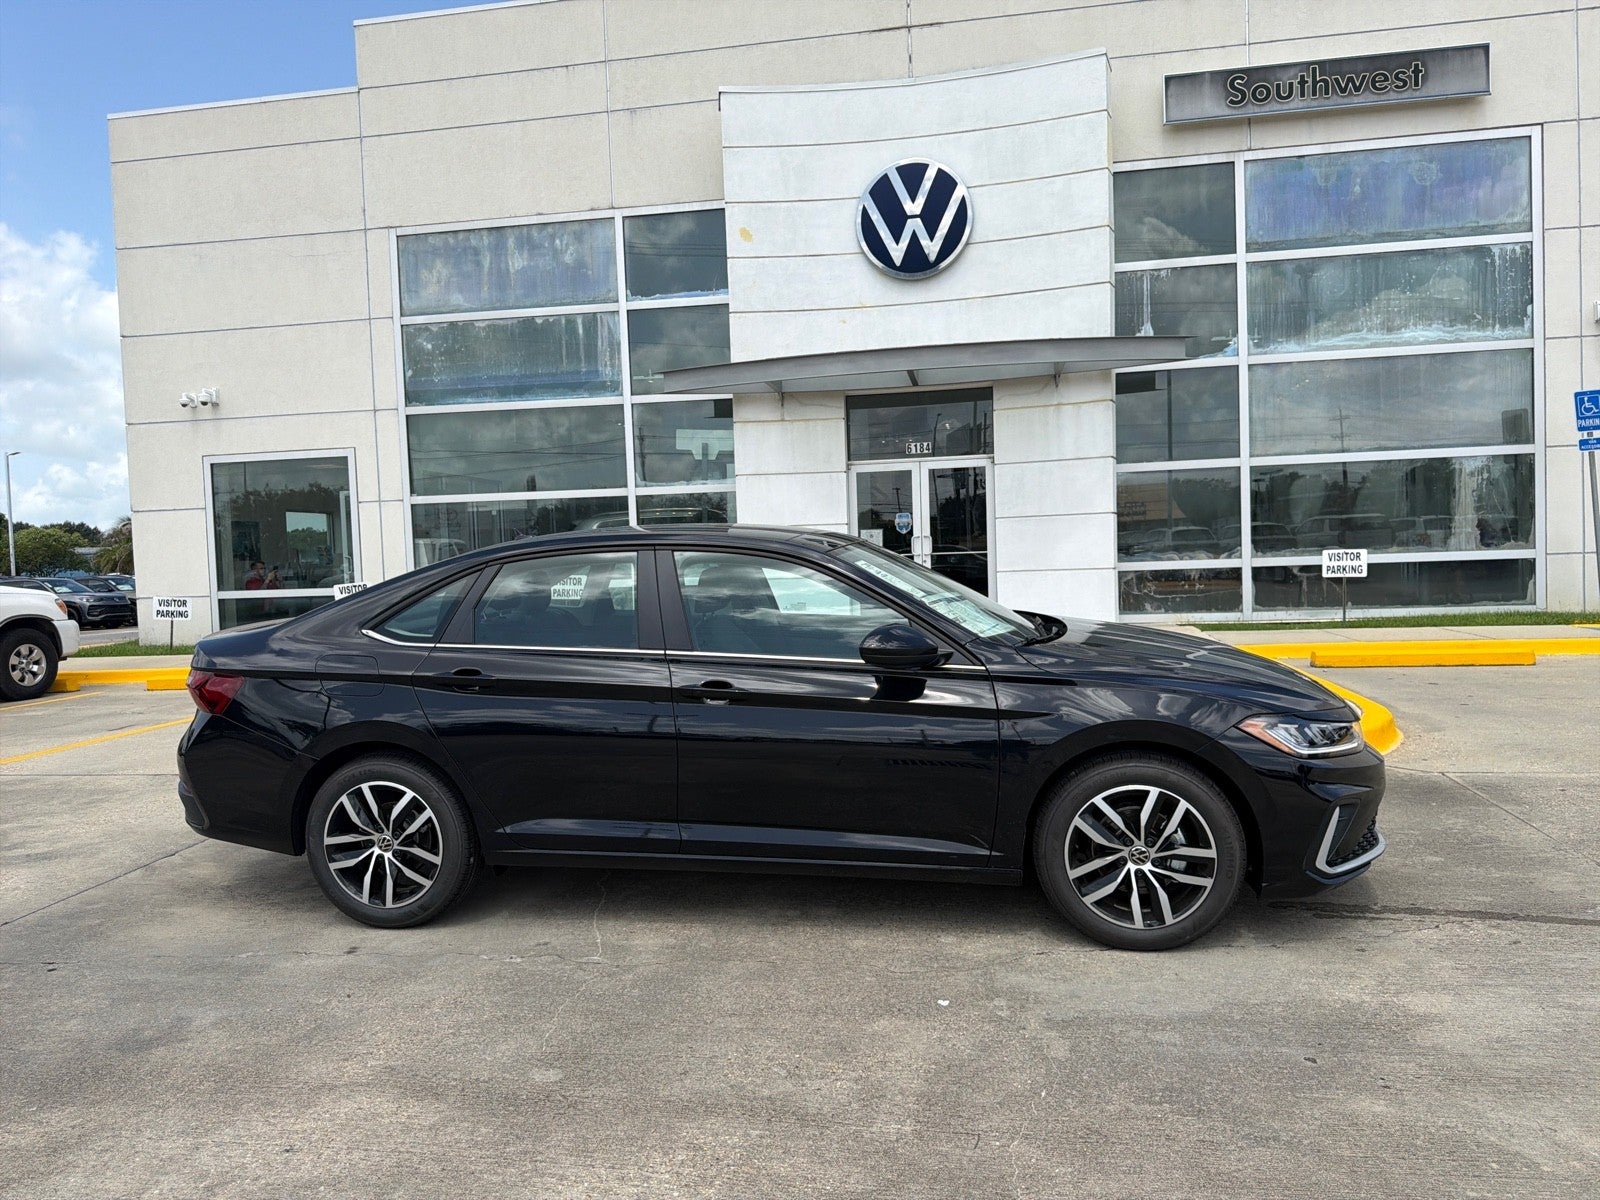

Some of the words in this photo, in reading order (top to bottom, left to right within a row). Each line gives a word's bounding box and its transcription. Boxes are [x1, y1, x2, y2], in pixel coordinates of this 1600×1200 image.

[1226, 61, 1424, 107] Southwest
[859, 160, 970, 270] VW
[907, 443, 931, 454] 6184
[1328, 551, 1361, 562] VISITOR
[1326, 564, 1363, 575] PARKING
[157, 598, 188, 607] VISITOR
[156, 609, 189, 618] PARKING
